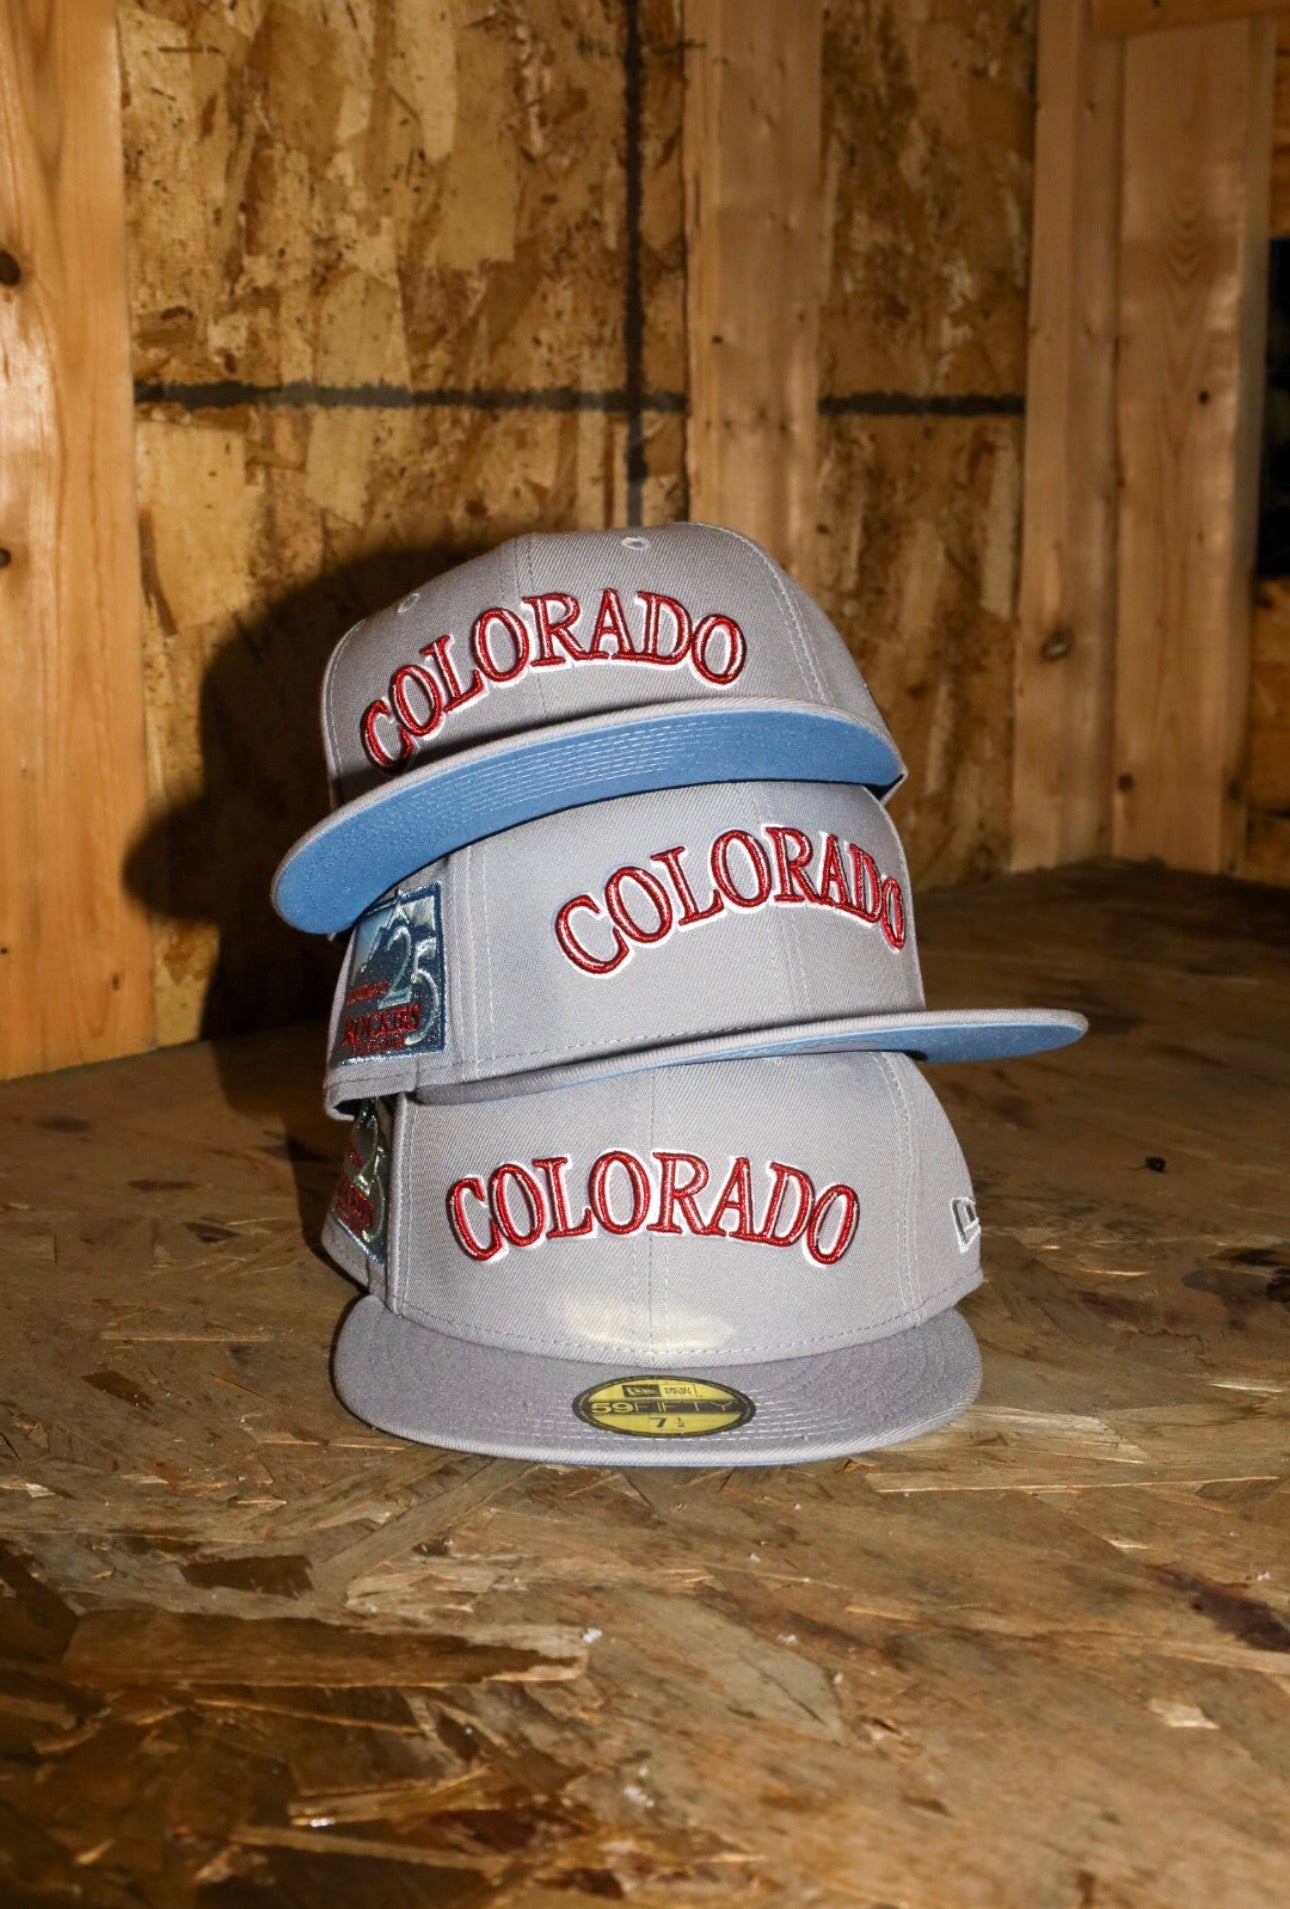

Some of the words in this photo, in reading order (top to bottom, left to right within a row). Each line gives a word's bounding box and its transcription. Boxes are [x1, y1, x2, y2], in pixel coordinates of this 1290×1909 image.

[361, 588, 747, 769] COLORADO
[555, 825, 905, 975] COLORADO
[378, 925, 440, 1046] 25
[447, 1150, 860, 1266] COLORADO
